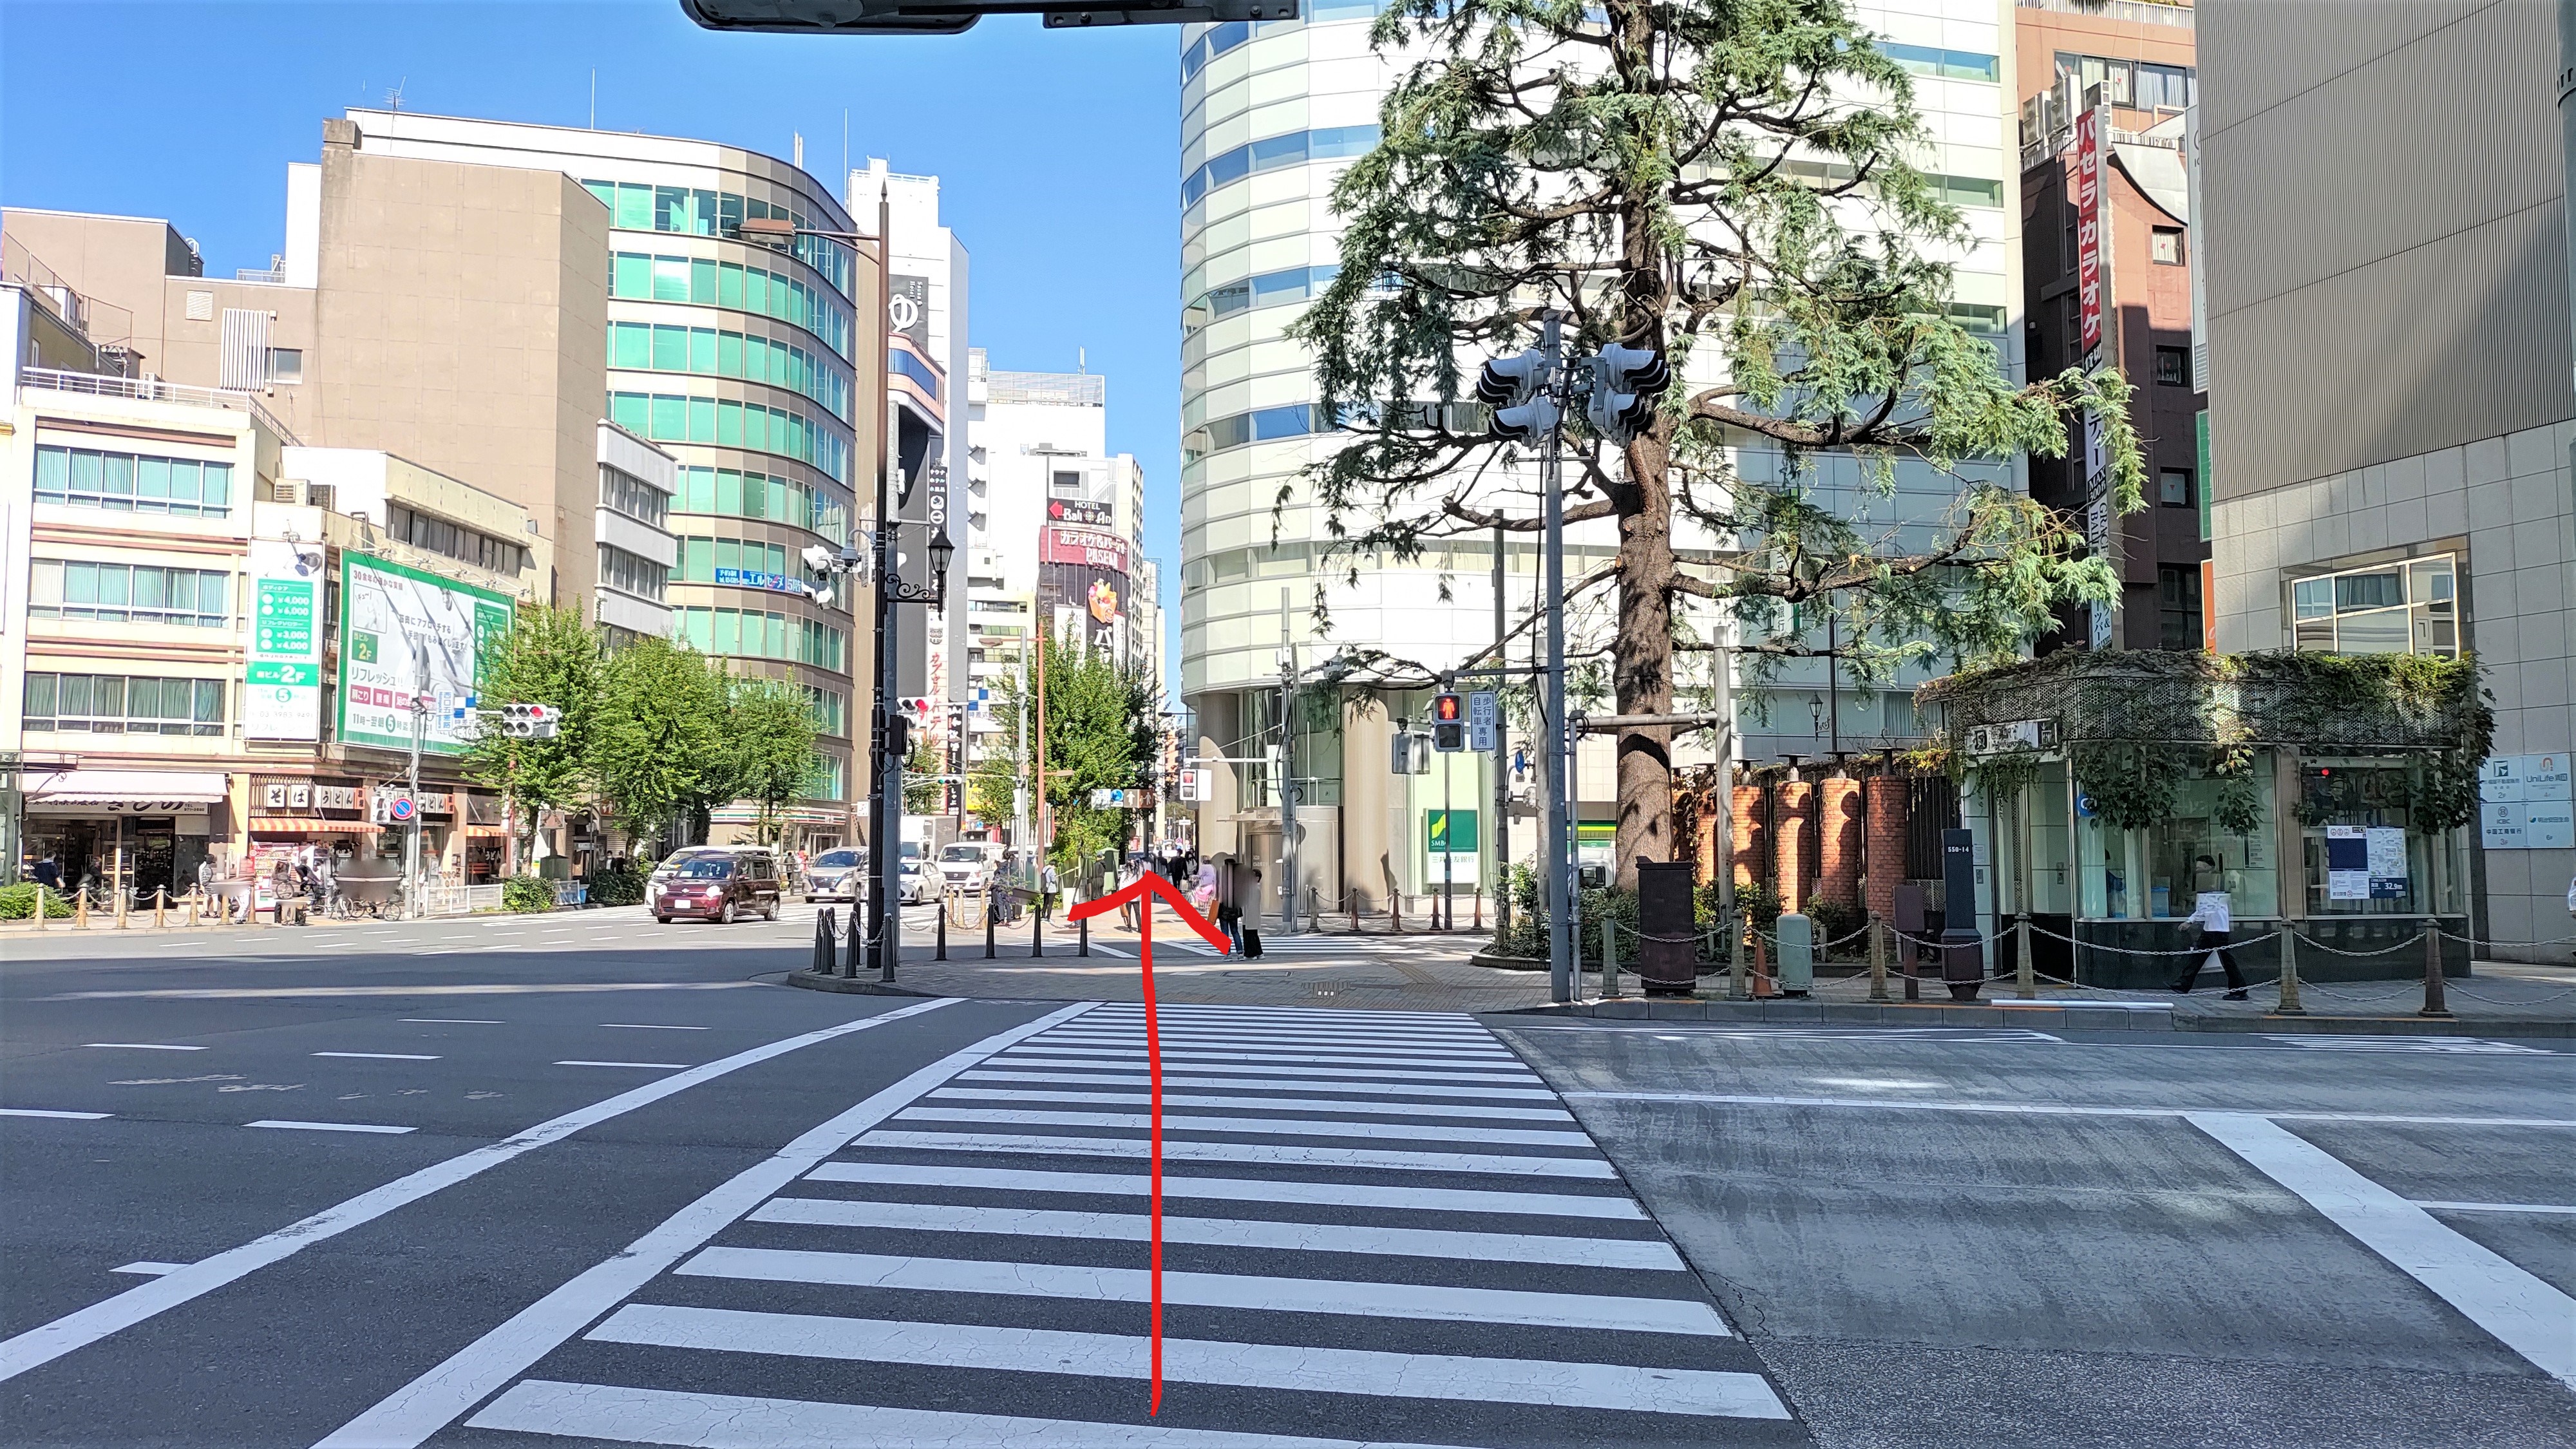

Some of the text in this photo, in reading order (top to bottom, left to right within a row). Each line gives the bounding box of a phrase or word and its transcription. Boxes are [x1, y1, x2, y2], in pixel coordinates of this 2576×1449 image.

[2089, 467, 2106, 491] MAX
[1075, 500, 1101, 510] HOTEL
[1095, 511, 1112, 524] An
[787, 578, 801, 592] 5階
[359, 643, 372, 660] 2F
[1473, 697, 1482, 726] 自転車
[1483, 697, 1492, 726] 歩行者
[1478, 727, 1487, 746] 専用
[2526, 775, 2555, 783] UniLife
[323, 789, 353, 805] うどん
